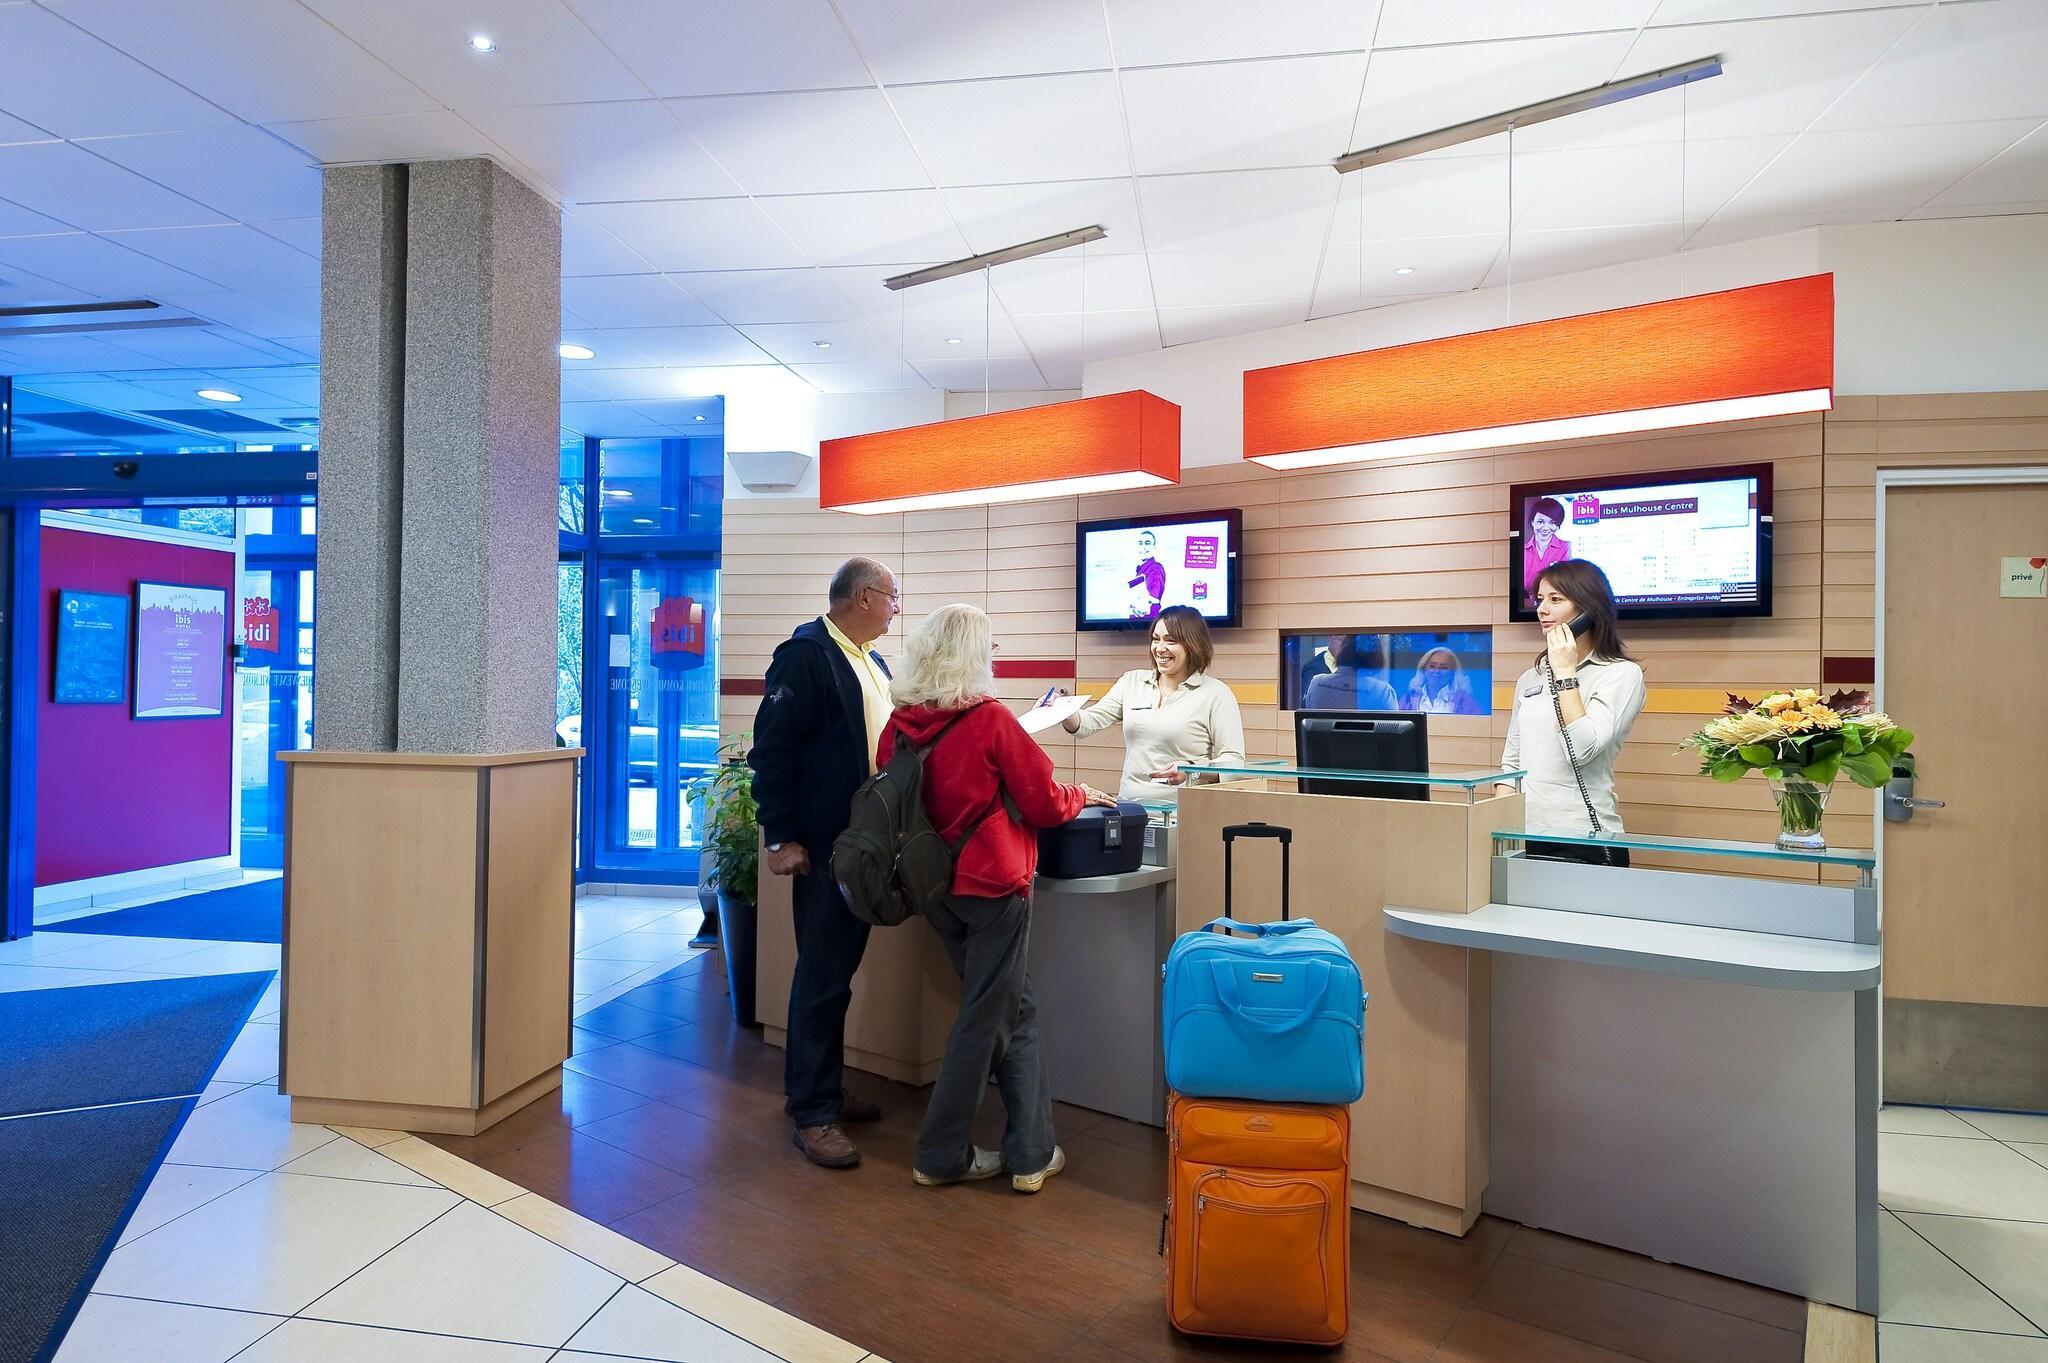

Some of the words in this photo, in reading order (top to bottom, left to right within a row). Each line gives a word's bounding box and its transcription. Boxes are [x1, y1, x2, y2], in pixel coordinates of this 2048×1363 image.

[1620, 504, 1662, 514] Mulhouse
[1664, 502, 1694, 511] Centre
[2011, 573, 2033, 582] privé
[175, 613, 191, 624] ibis
